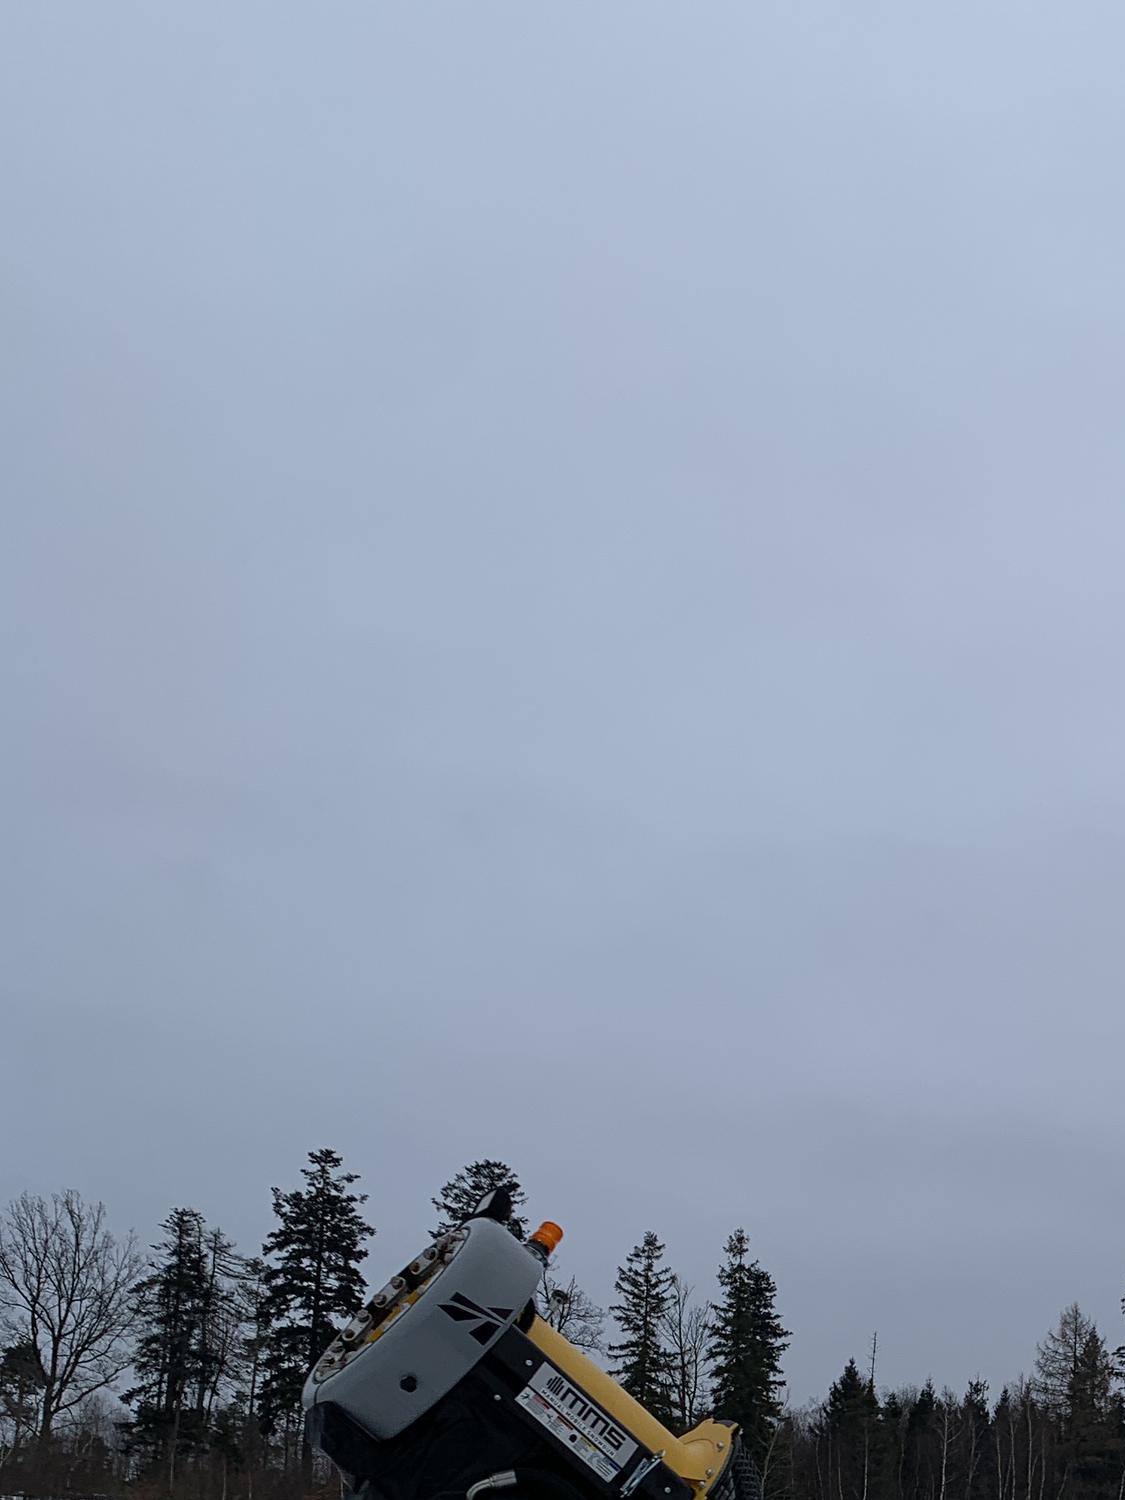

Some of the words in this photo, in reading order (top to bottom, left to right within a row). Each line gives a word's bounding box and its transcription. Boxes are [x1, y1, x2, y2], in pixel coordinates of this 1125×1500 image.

[541, 1389, 565, 1412] MANUAL
[565, 1410, 587, 1431] MOBILE
[586, 1430, 615, 1456] SNOWGUN
